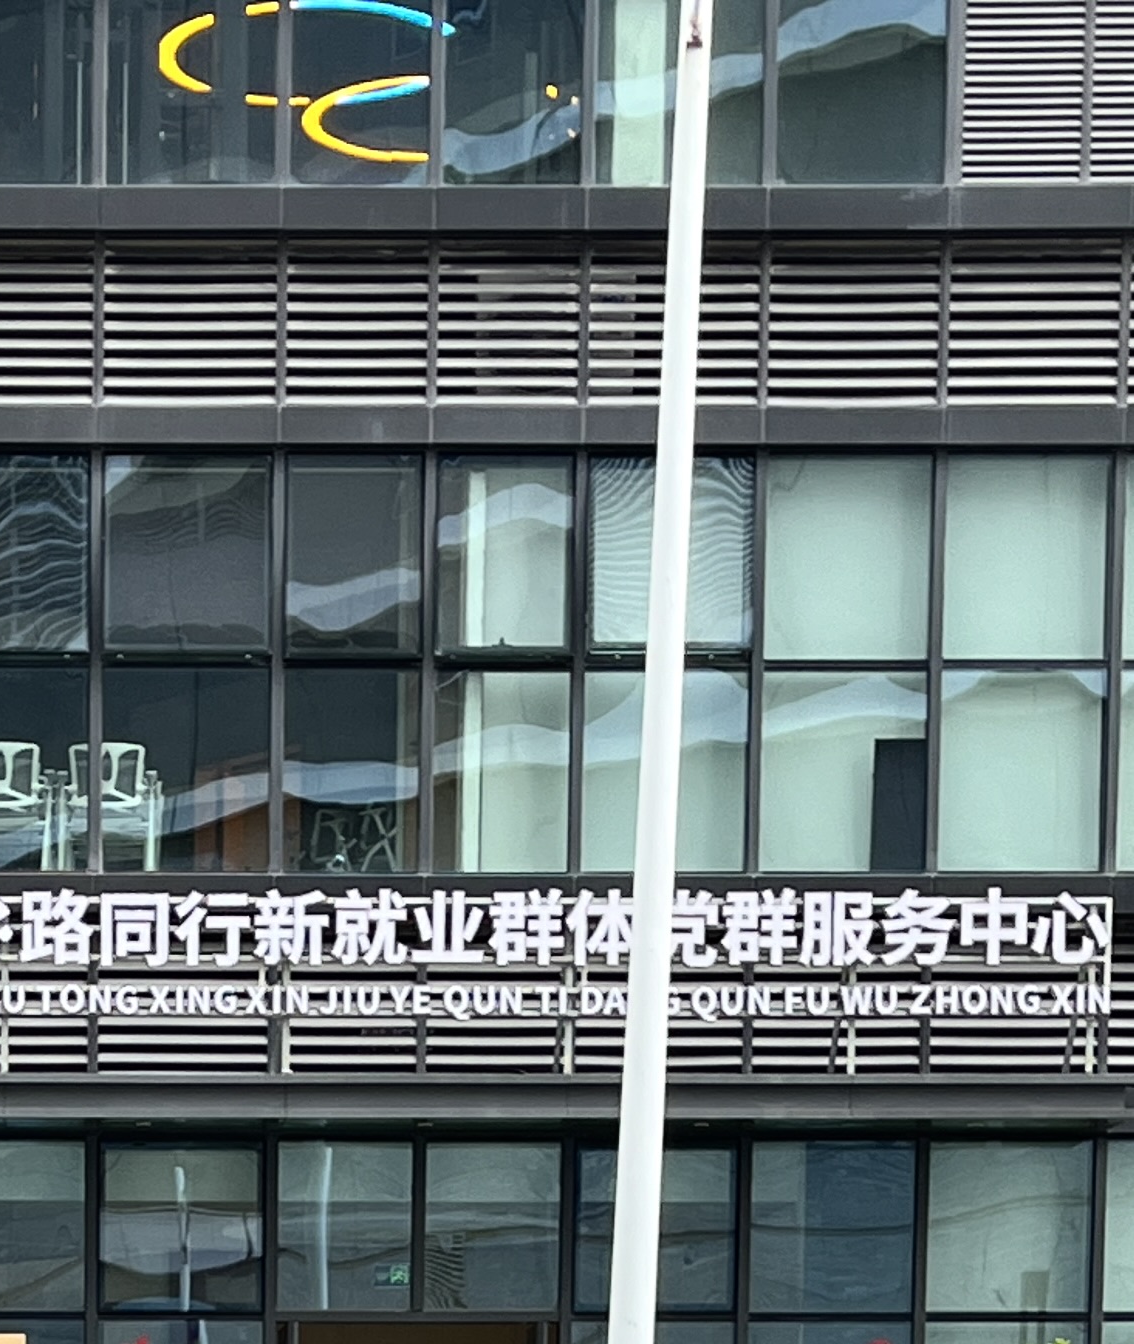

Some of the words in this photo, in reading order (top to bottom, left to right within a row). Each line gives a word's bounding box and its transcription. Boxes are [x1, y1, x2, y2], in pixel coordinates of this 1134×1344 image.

[36, 984, 139, 1014] TONG
[149, 984, 238, 1015] XING
[245, 985, 309, 1015] XIN
[319, 985, 380, 1015] JIU
[388, 985, 431, 1014] YE
[443, 985, 523, 1021] QUN
[534, 986, 568, 1014] TI
[581, 986, 681, 1016] DAG
[691, 986, 771, 1022] QUN
[784, 986, 830, 1015] FU
[840, 985, 898, 1015] WU
[909, 985, 1041, 1015] ZHONG
[1050, 984, 1111, 1014] XIN
